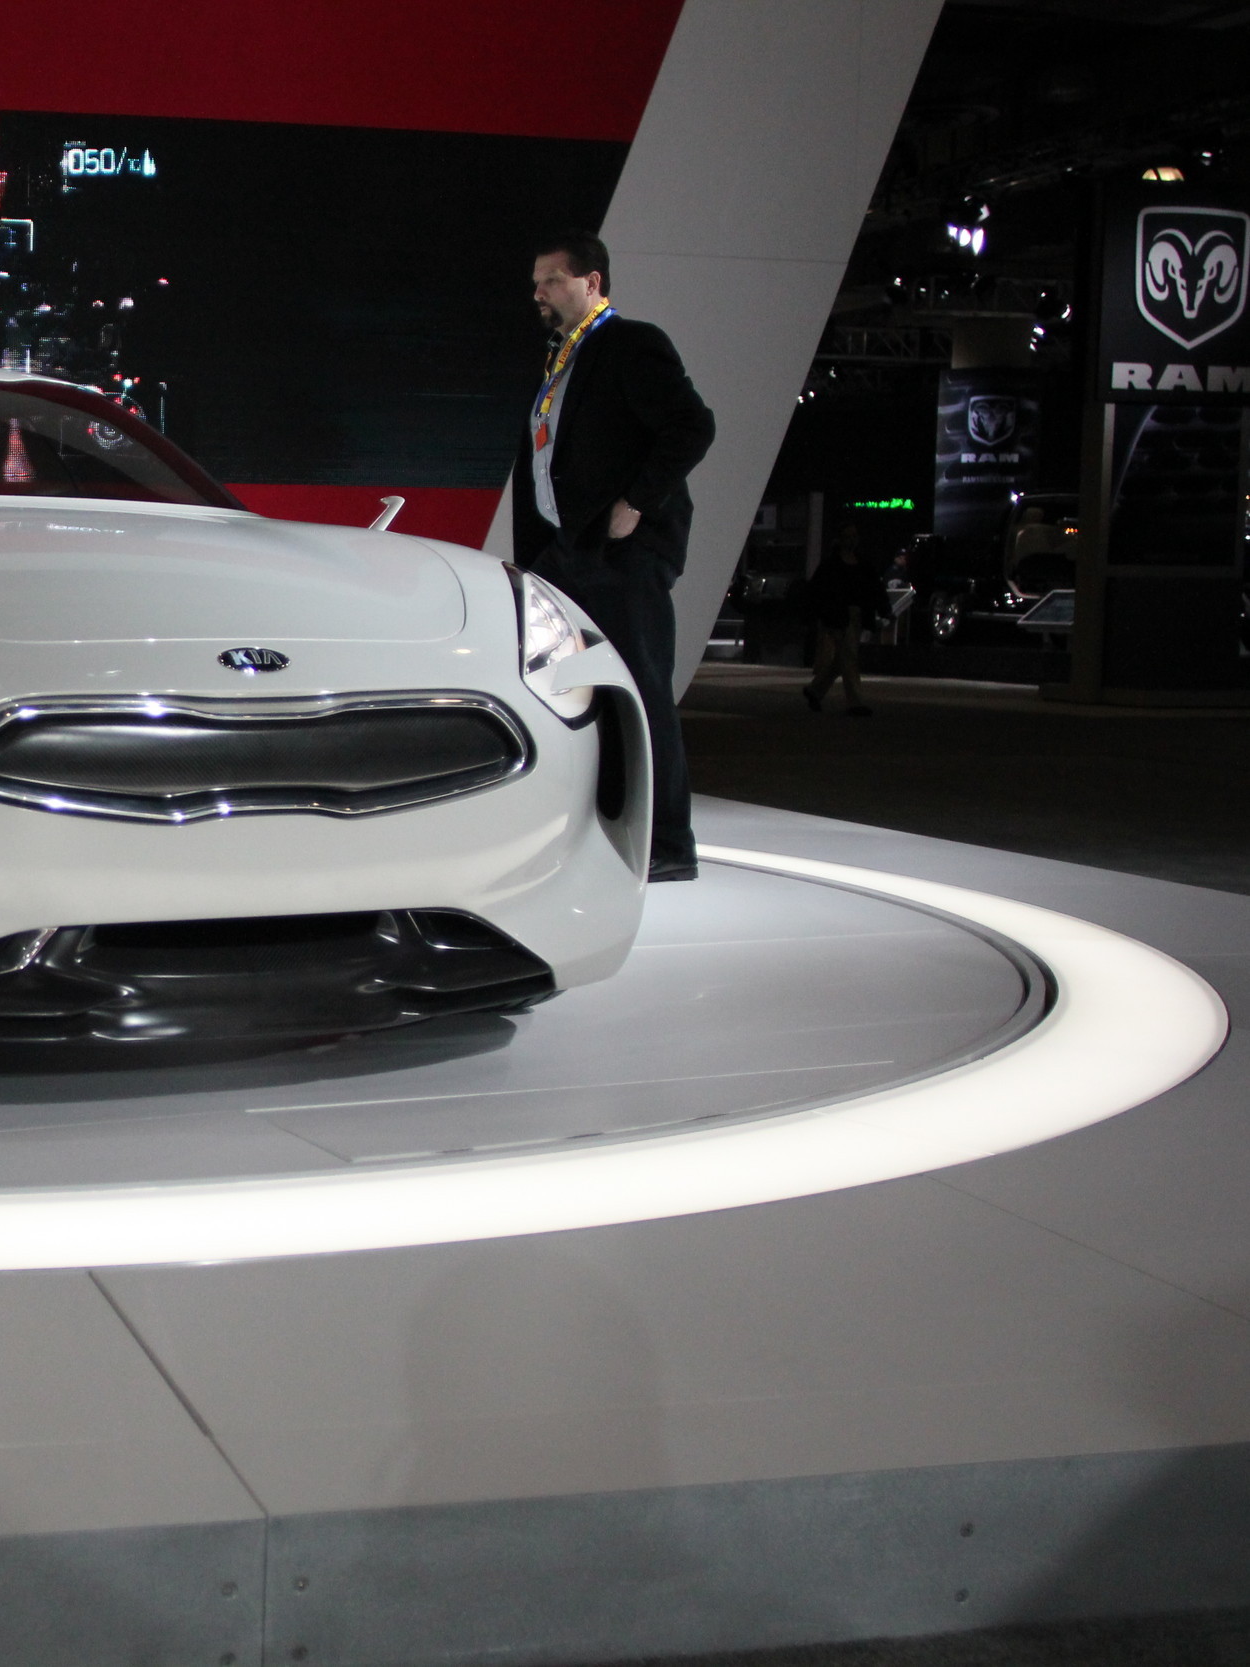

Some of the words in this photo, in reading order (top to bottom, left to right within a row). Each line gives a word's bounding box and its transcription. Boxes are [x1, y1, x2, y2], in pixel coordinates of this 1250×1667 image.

[1111, 361, 1250, 393] RAM
[960, 452, 1020, 464] RAM
[227, 649, 283, 666] KIA
